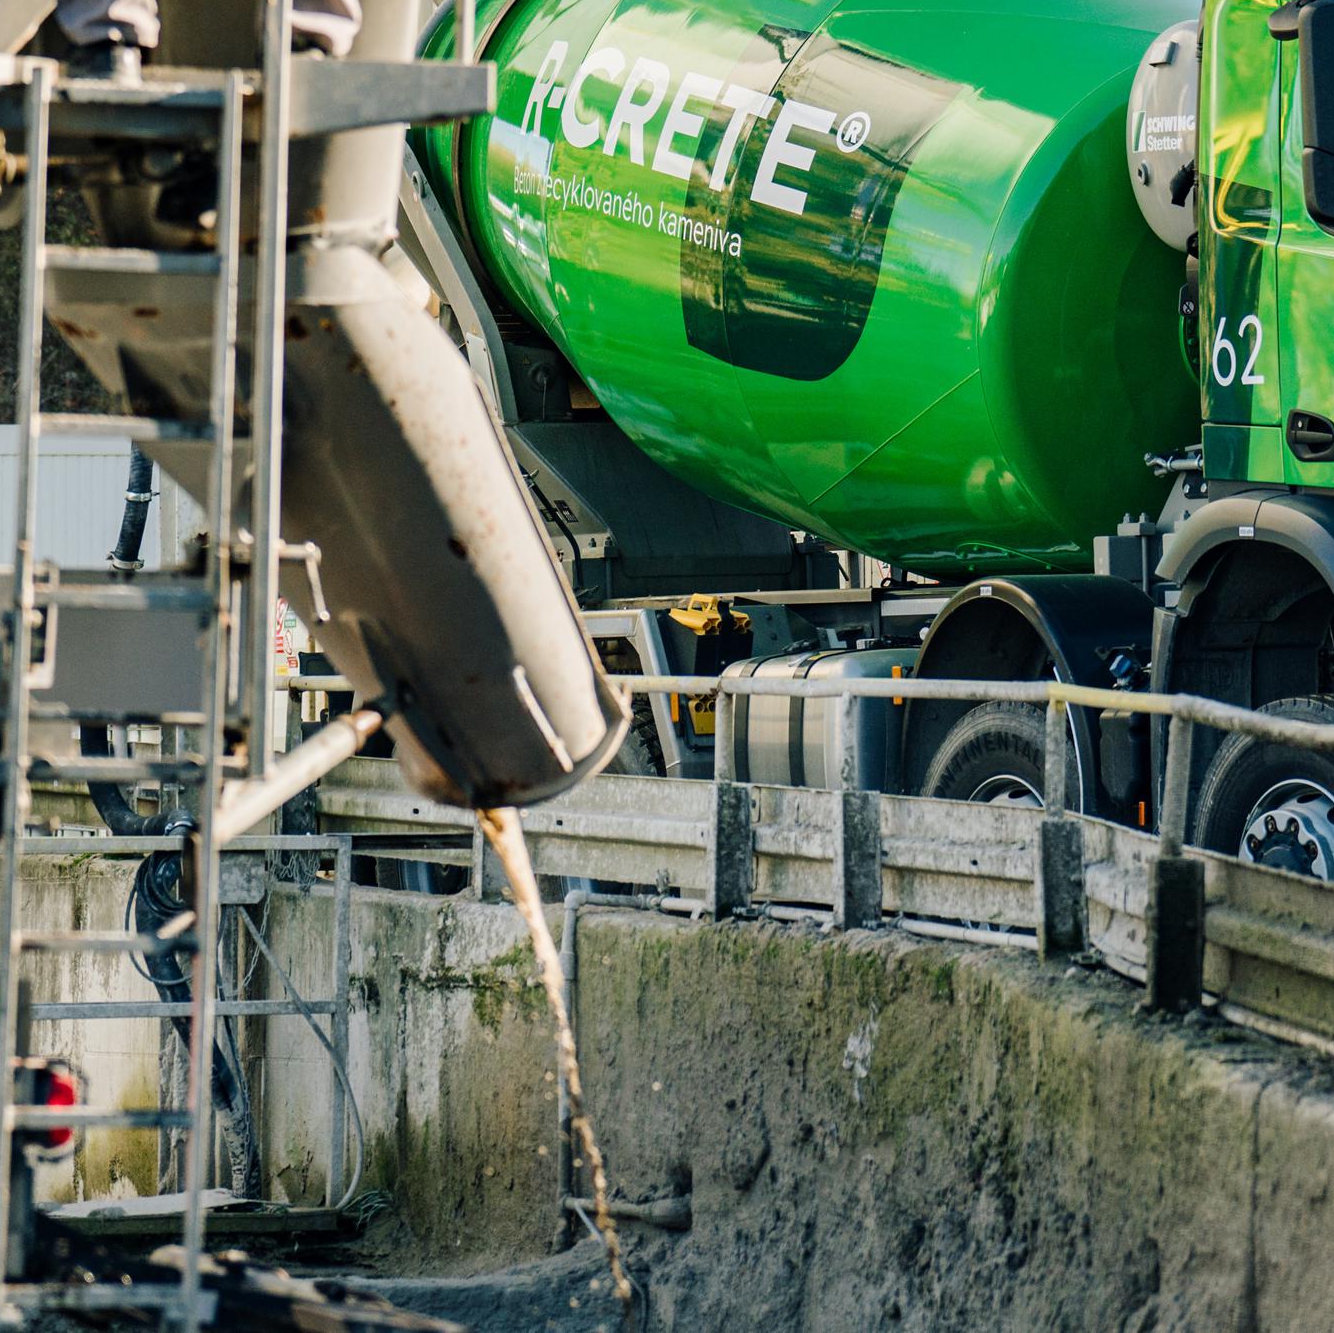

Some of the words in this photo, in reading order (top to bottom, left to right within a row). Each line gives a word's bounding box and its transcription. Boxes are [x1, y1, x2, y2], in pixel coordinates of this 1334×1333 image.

[1147, 114, 1196, 134] SCHWING
[1147, 135, 1182, 152] Stetter
[658, 200, 743, 257] kameniva
[1212, 314, 1265, 387] 62
